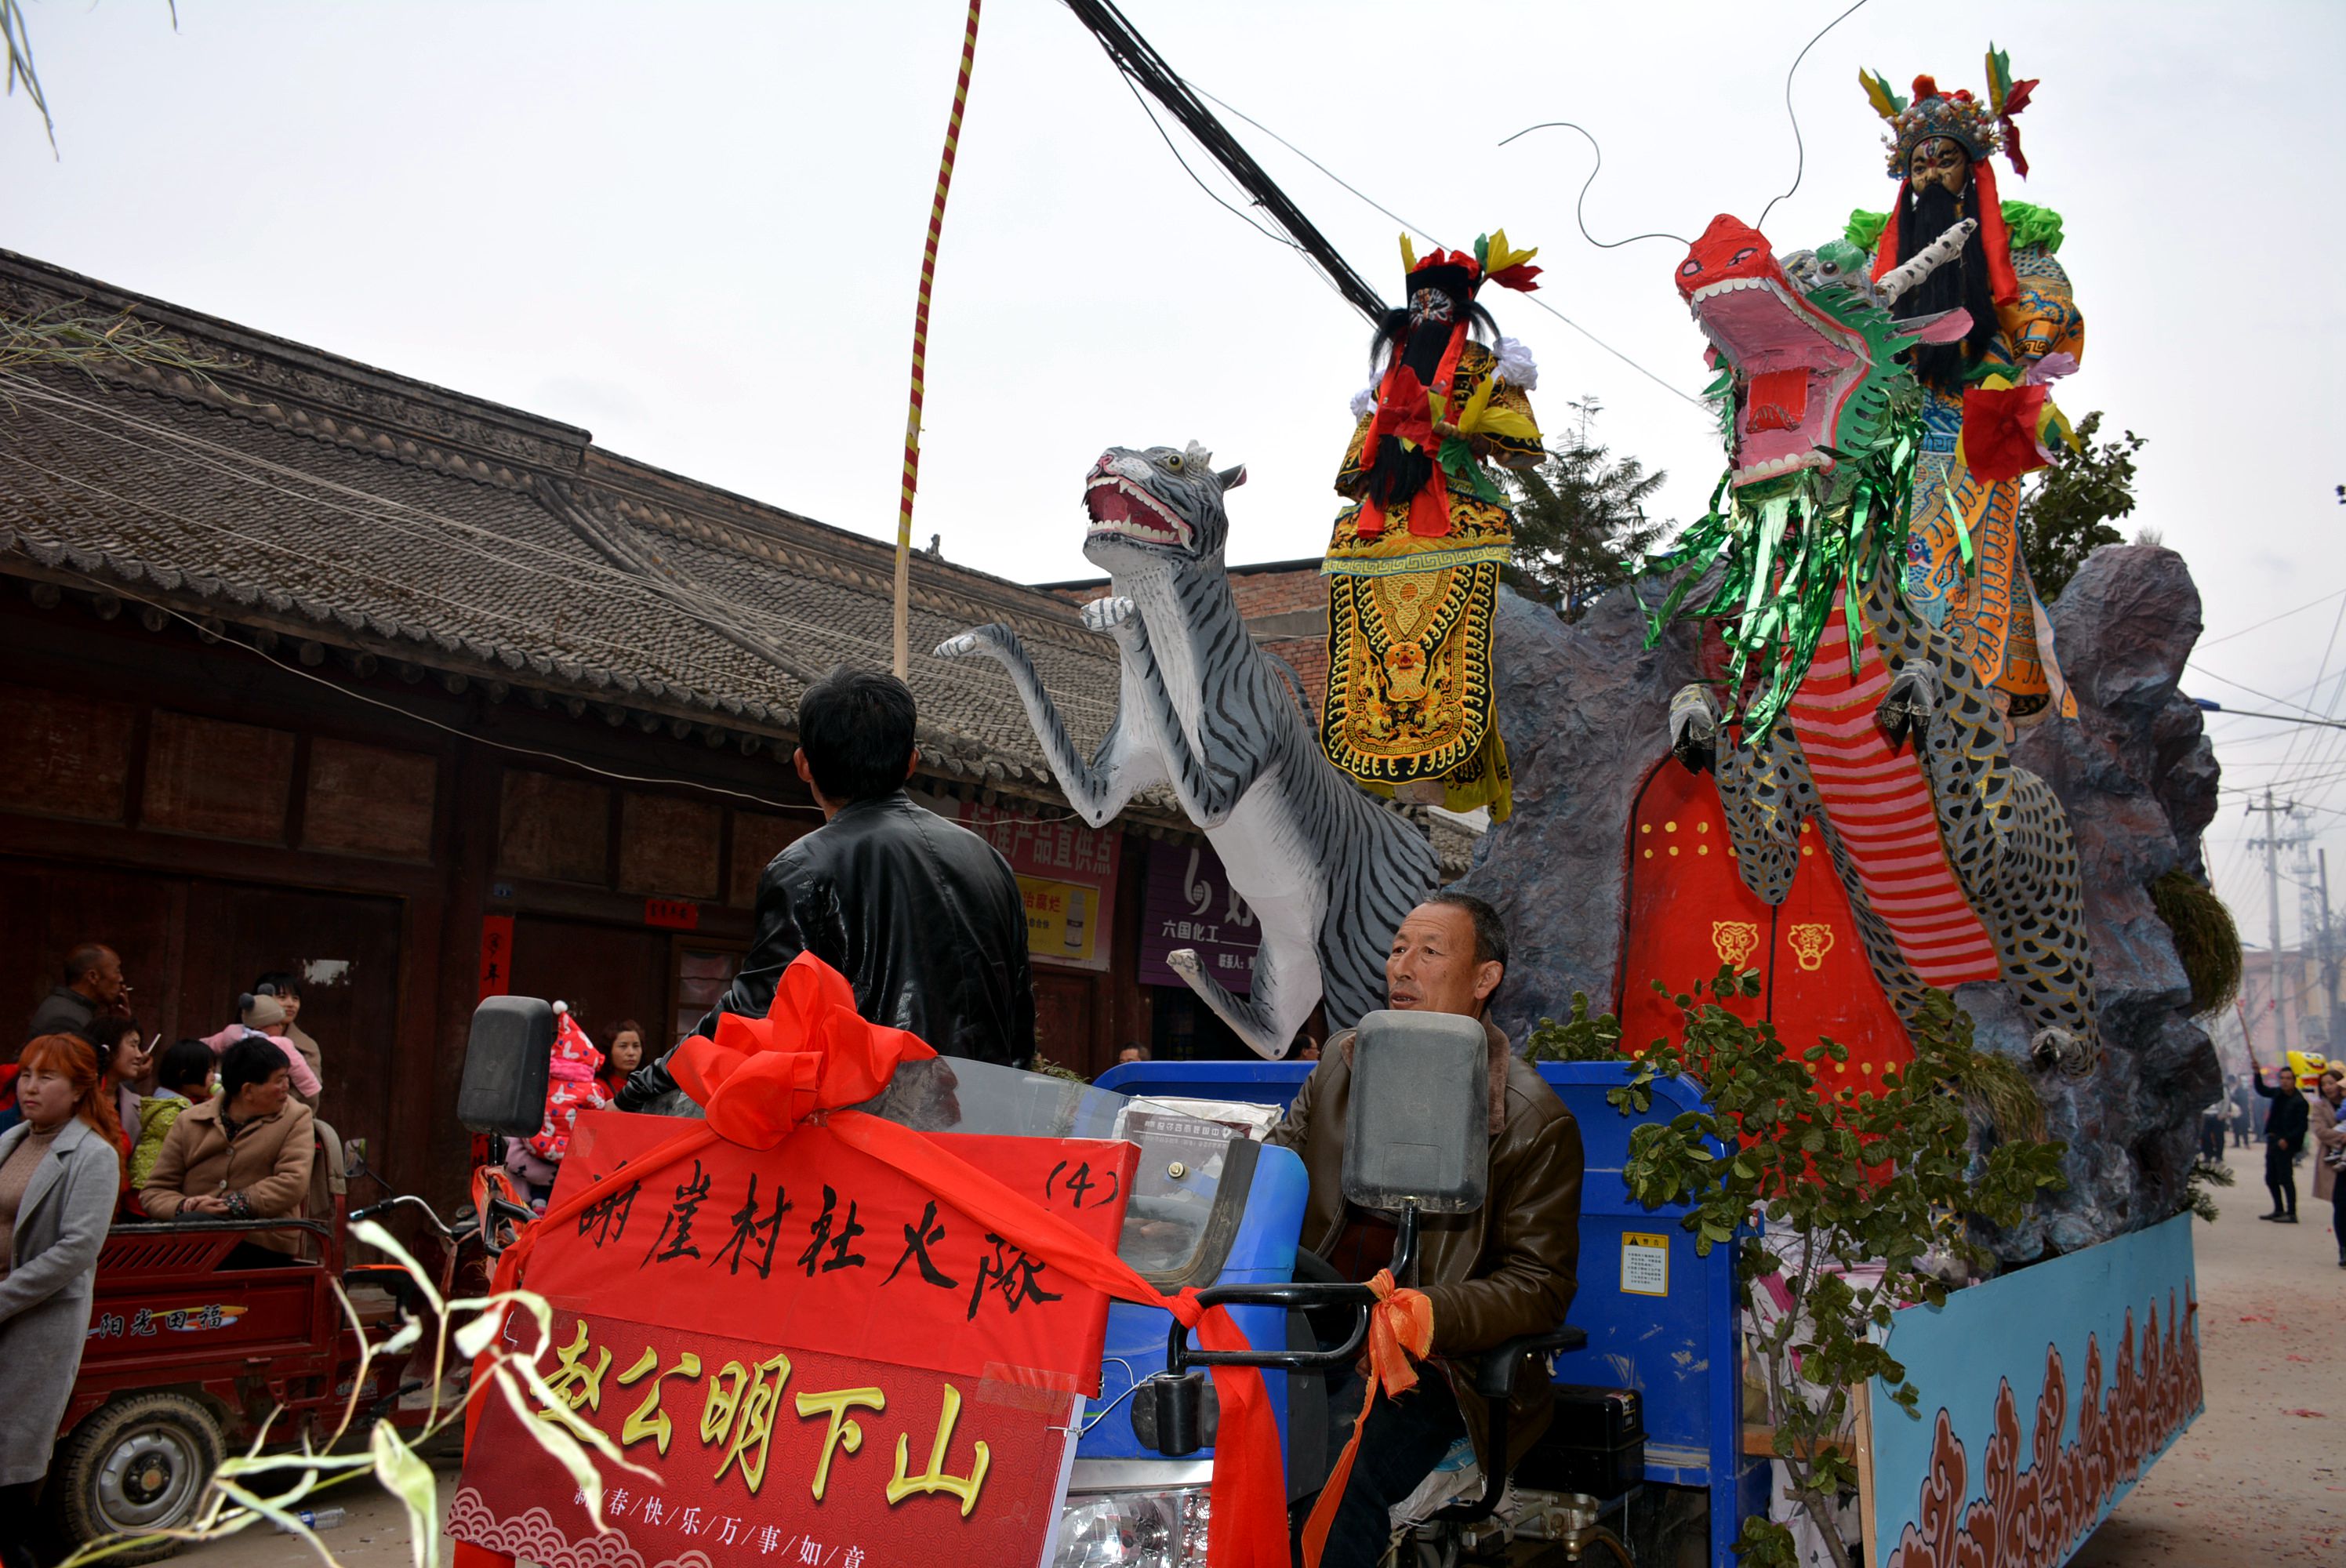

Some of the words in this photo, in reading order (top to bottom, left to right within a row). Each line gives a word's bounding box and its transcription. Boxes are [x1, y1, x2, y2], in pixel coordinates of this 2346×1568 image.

[1162, 920, 1219, 943] 六国化工
[1045, 1160, 1119, 1210] (4)
[528, 1319, 990, 1516] 赵公明下山
